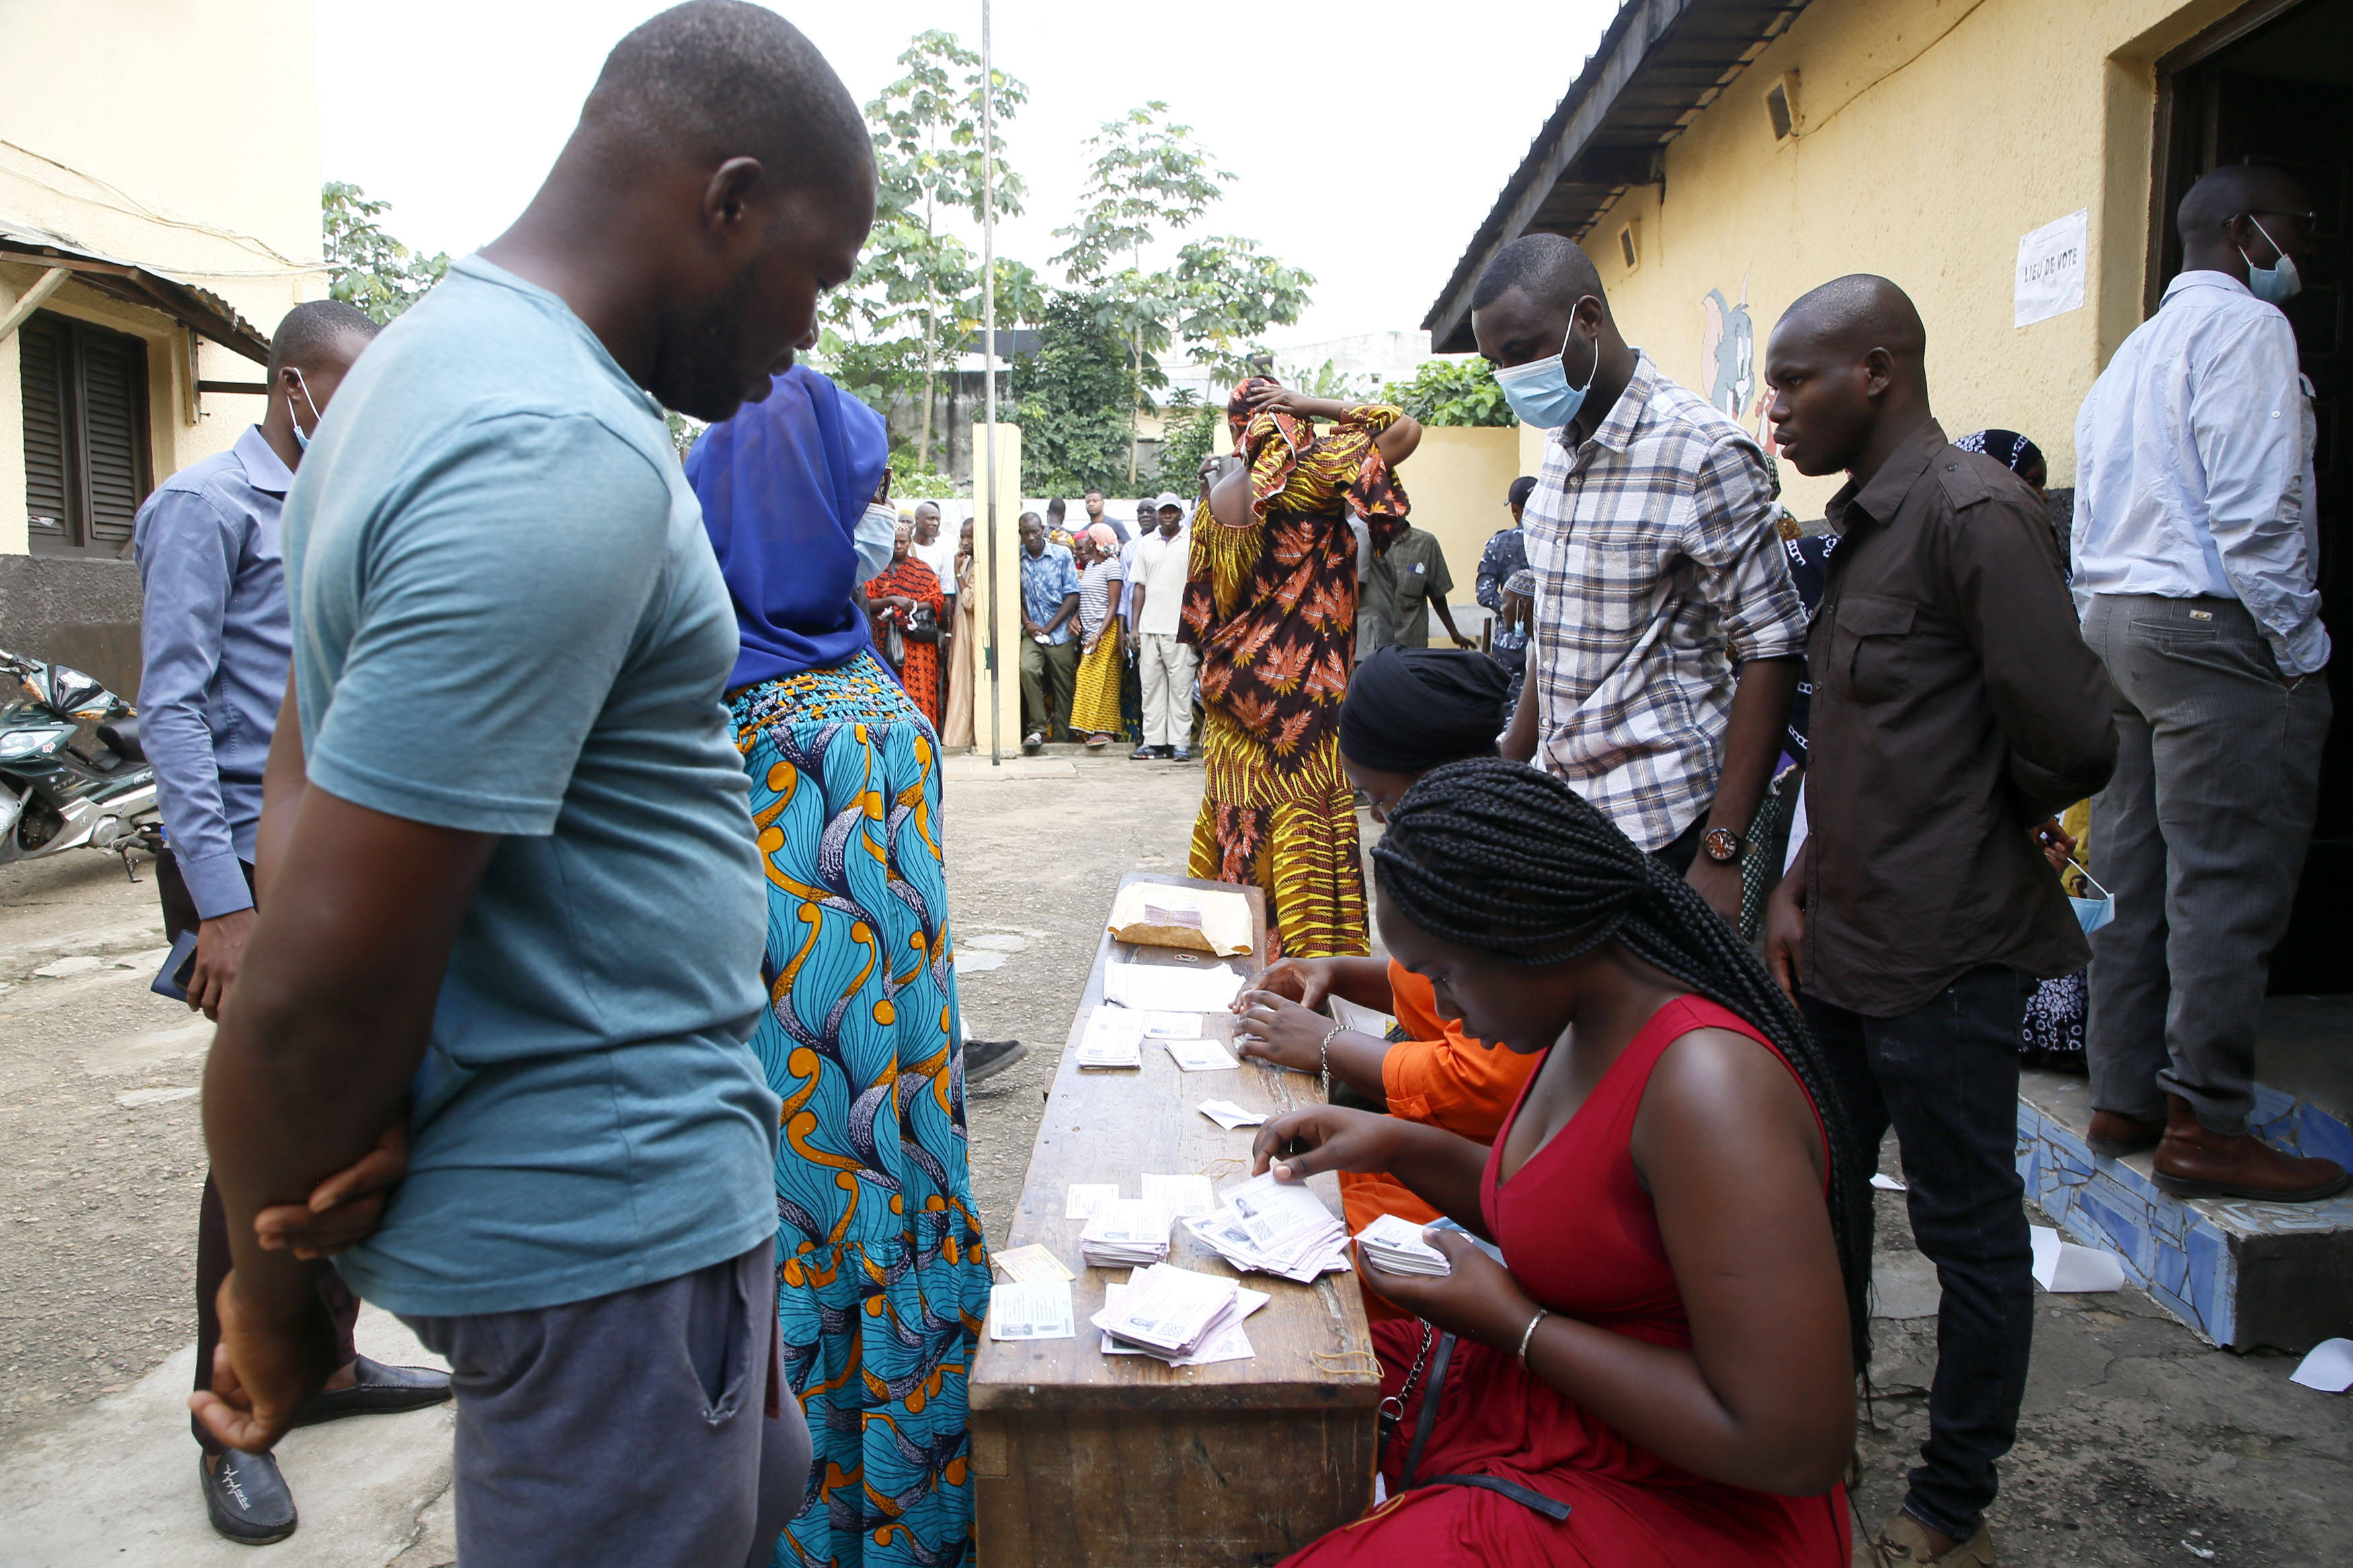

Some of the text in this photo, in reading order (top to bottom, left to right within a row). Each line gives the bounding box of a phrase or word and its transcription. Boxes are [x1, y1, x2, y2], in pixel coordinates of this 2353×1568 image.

[2025, 247, 2078, 283] LIEU DE VOTE
[53, 775, 76, 791] KTM
